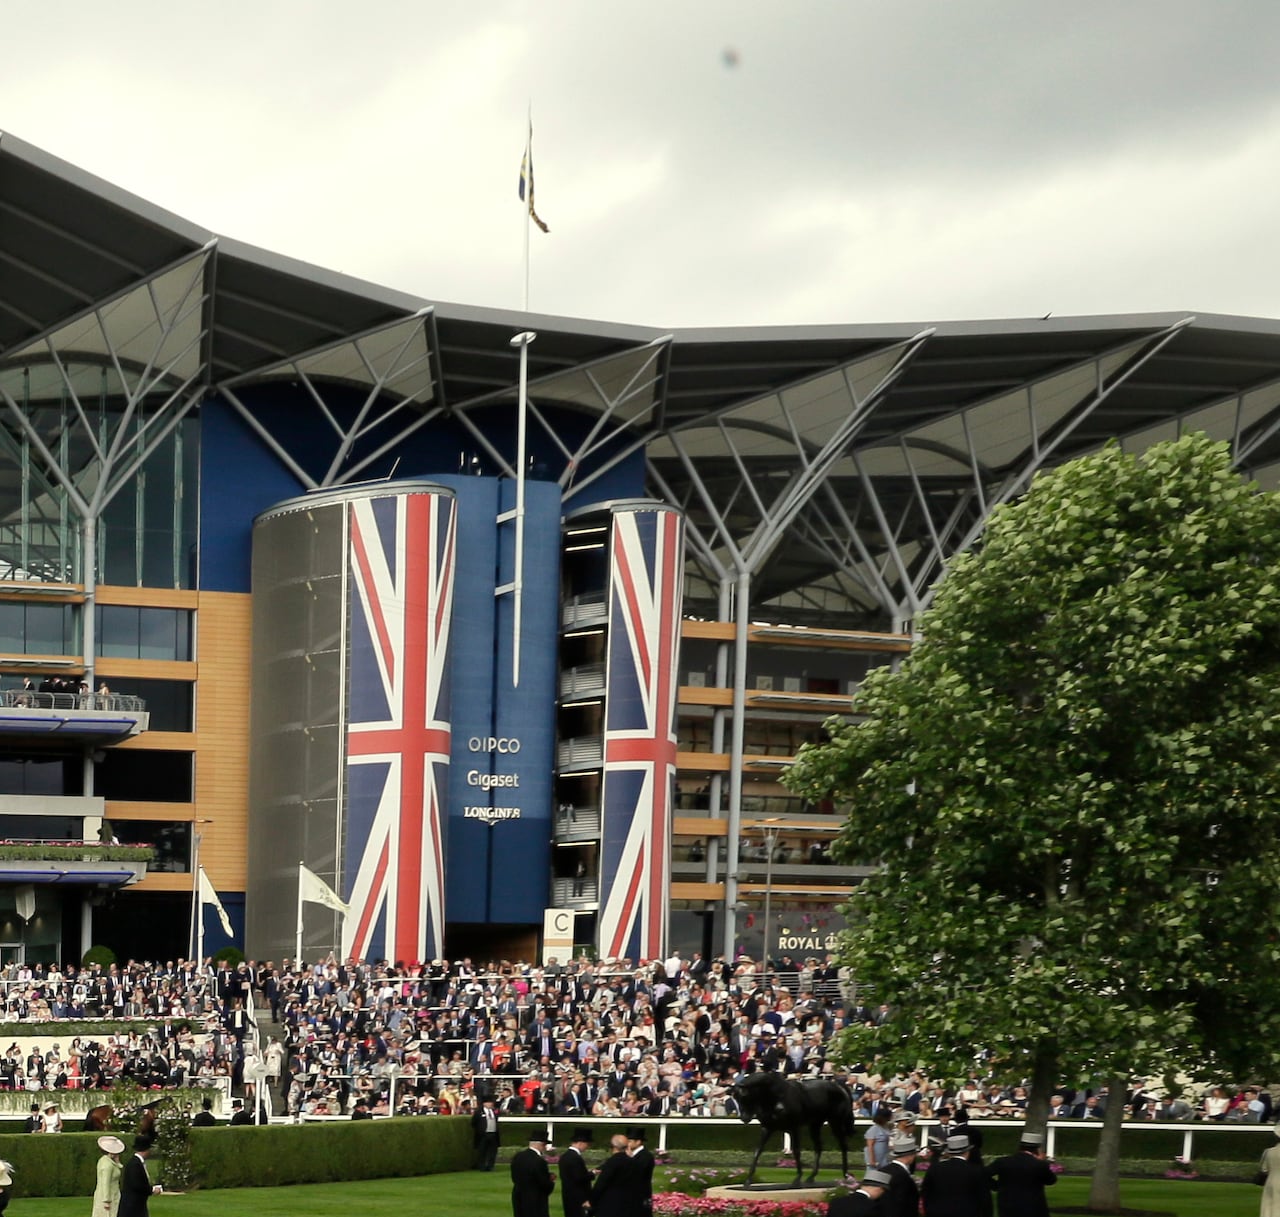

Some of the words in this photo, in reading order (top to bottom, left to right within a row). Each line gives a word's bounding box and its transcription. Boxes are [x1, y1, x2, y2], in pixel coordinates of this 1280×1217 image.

[467, 770, 520, 791] Gigaset
[554, 913, 569, 932] C
[778, 936, 823, 950] ROYAL
